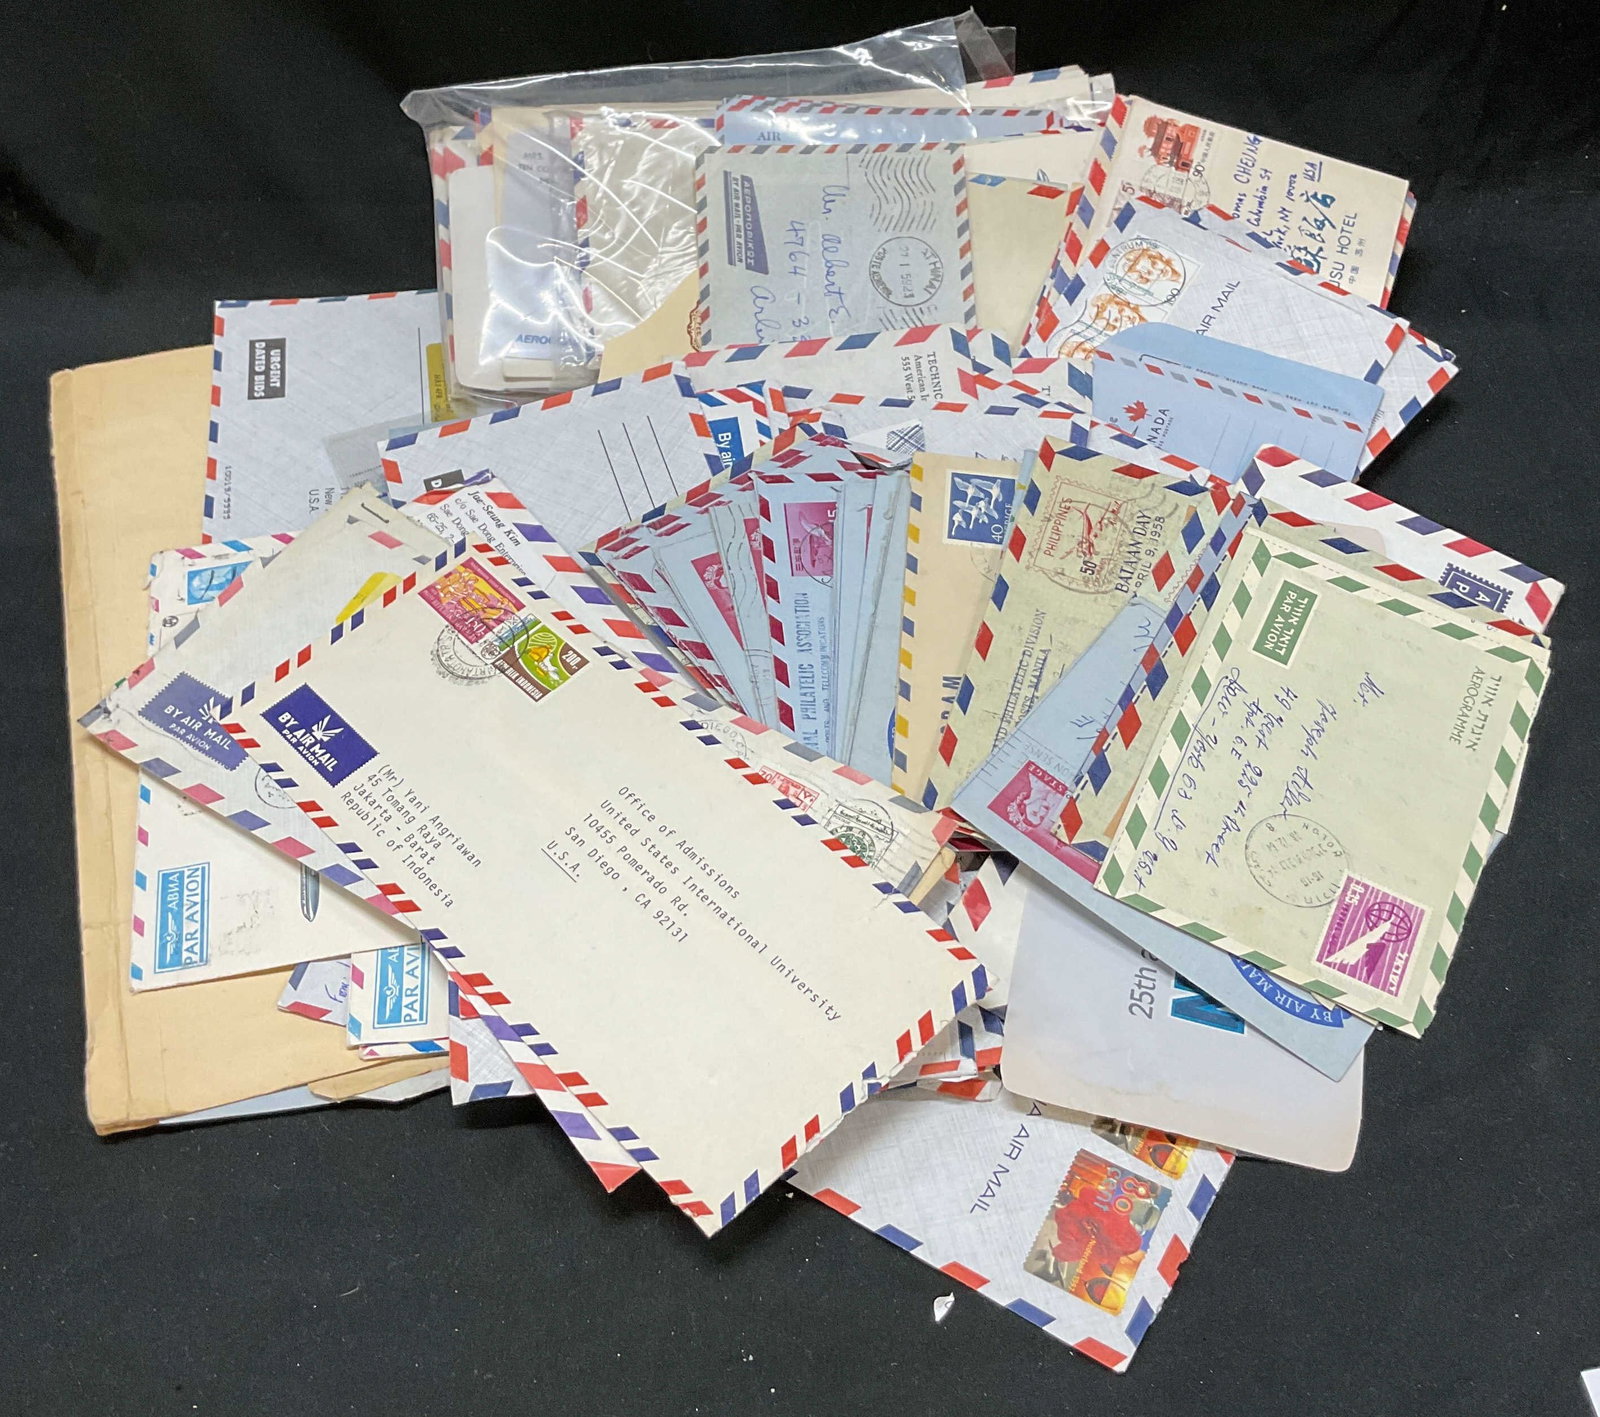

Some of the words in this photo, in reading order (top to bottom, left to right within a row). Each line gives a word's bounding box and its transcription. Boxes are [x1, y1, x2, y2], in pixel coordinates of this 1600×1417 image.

[756, 131, 781, 141] AIR
[1234, 134, 1263, 184] CHEUNG
[1302, 161, 1318, 182] USA
[1232, 192, 1247, 219] omas
[784, 220, 810, 277] 4764
[1336, 212, 1358, 255] HOTEL
[1195, 314, 1216, 335] AIR
[1211, 280, 1241, 312] MAIL
[254, 341, 266, 372] DATED
[269, 348, 281, 388] URGENT
[901, 355, 909, 372] 555
[914, 354, 928, 393] American
[254, 375, 265, 398] BIDS
[903, 373, 914, 394] West
[717, 431, 732, 450] By
[1147, 408, 1170, 445] NADA
[324, 487, 335, 506] New
[440, 503, 453, 518] Sae
[452, 517, 470, 536] Dong
[455, 498, 467, 510] c/o
[466, 509, 479, 523] Sae
[478, 523, 496, 544] Dong
[468, 491, 506, 529] Jae-Seung
[504, 529, 521, 547] Kim
[991, 523, 1004, 542] 40
[1043, 497, 1073, 557] PHILIPPINES
[1080, 560, 1097, 576] 50
[1114, 539, 1143, 594] BATAAN
[1132, 510, 1152, 537] DAY
[1280, 590, 1297, 612] PAR
[1024, 608, 1047, 657] DIVISION
[1264, 614, 1285, 650] AVION
[1028, 648, 1051, 689] MANILA
[798, 663, 817, 726] PHILATELIC
[1274, 686, 1298, 711] 49
[1449, 666, 1486, 746] AEROGRAMME
[164, 705, 182, 718] BY
[180, 713, 200, 731] AIR
[204, 728, 232, 752] MAIL
[169, 722, 185, 737] PAR
[186, 732, 212, 751] AVION
[278, 711, 299, 729] BY
[294, 726, 317, 747] AIR
[309, 744, 340, 773] MAIL
[282, 729, 298, 744] PAR
[297, 744, 320, 767] AVION
[1028, 763, 1065, 793] STAGE
[353, 783, 393, 823] Jakarta
[404, 833, 436, 866] Barat
[367, 774, 382, 788] 45
[382, 788, 416, 825] Tomang
[417, 824, 442, 850] Raya
[377, 764, 405, 788] (Mr)
[404, 788, 430, 814] Yani
[429, 815, 482, 868] Angriawan
[340, 791, 386, 838] Republic
[386, 839, 404, 852] of
[402, 854, 454, 908] Indonesia
[546, 840, 580, 878] U.S.A.
[618, 786, 656, 822] Office
[658, 824, 677, 838] of
[675, 839, 740, 899] Admissions
[583, 812, 617, 844] 10455
[616, 845, 668, 895] Pomerado
[670, 895, 689, 917] Rd.
[167, 872, 181, 911] АВИА
[184, 866, 201, 924] AVION
[564, 826, 586, 848] San
[587, 848, 620, 880] Diego
[634, 893, 651, 909] CA
[652, 910, 688, 943] 92131
[600, 799, 641, 837] United
[640, 837, 680, 875] States
[682, 875, 768, 954] International
[770, 955, 841, 1022] University
[184, 928, 200, 966] PAR
[404, 984, 419, 1023] PAR
[1128, 966, 1158, 1020] 25th
[1274, 995, 1305, 1013] AIR
[1310, 1009, 1333, 1022] BY
[1003, 1123, 1031, 1162] AIR
[969, 1163, 1010, 1215] MAIL
